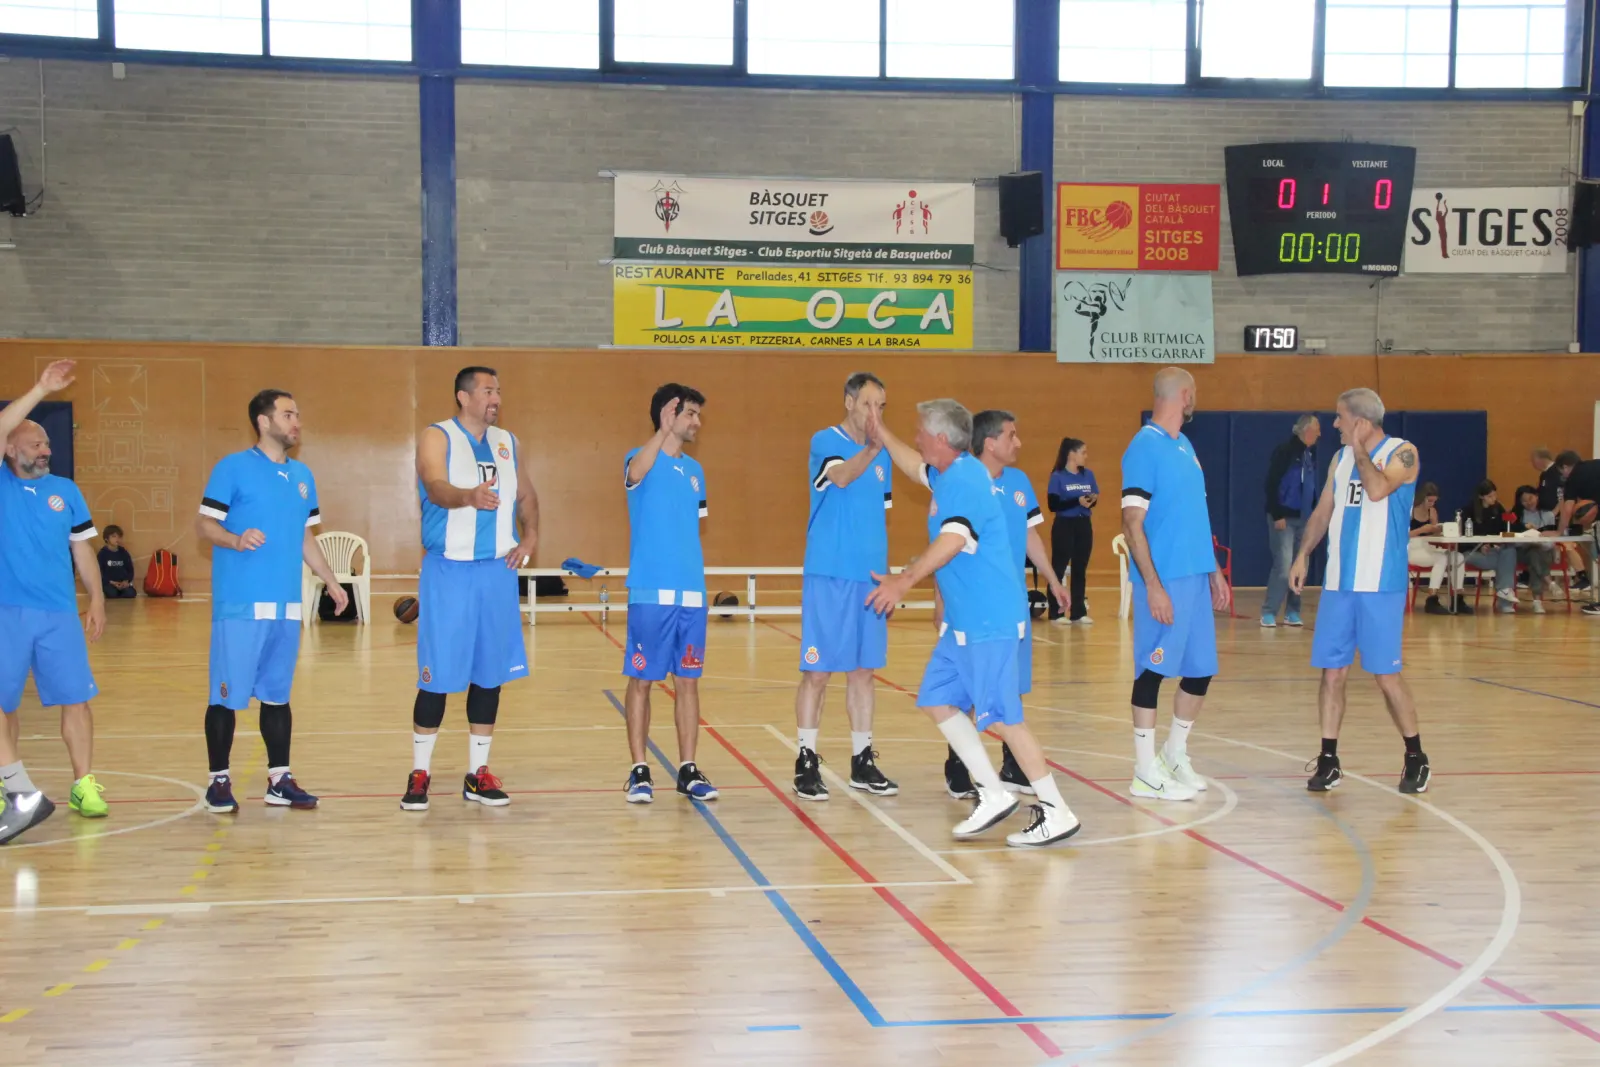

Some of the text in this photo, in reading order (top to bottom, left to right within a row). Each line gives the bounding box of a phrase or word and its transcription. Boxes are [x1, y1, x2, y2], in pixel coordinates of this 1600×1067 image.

[1352, 160, 1388, 168] VISITANTE
[749, 189, 829, 208] BÀSQUET
[1145, 193, 1180, 202] CIUTAT
[1278, 179, 1296, 209] 0
[1323, 183, 1330, 205] 1
[1374, 179, 1392, 209] 0
[1145, 203, 1215, 214] DEL BÀSQUET
[1306, 211, 1337, 219] PERIODO
[749, 210, 807, 226] SITGES
[1066, 208, 1102, 226] FBC
[1145, 213, 1184, 224] CATALÀ
[1554, 208, 1569, 246] 2008
[1144, 230, 1204, 244] SITGES
[638, 244, 664, 255] Club
[666, 244, 712, 257] Bàsquet
[713, 245, 747, 259] Sitges
[757, 247, 783, 257] Club
[785, 247, 832, 260] Esportiu
[833, 248, 873, 260] Sitgetà
[874, 248, 888, 259] de
[890, 249, 952, 262] Basquetbol
[1144, 247, 1189, 261] 2008
[1280, 232, 1360, 262] 00:00
[615, 266, 725, 281] RESTAURANTE
[817, 272, 862, 282] SITGES
[894, 273, 908, 283] 93
[912, 273, 933, 284] 894
[938, 274, 952, 284] 79
[958, 274, 971, 284] 36
[654, 286, 953, 330] LA OCA
[653, 334, 696, 344] POLLOS
[700, 335, 707, 344] A
[750, 336, 805, 347] PIZZERIA,
[810, 337, 853, 346] CARNES
[857, 337, 864, 346] A
[868, 337, 881, 346] LA
[886, 338, 920, 347] BRASA
[1100, 332, 1205, 345] CLUB RITMICA
[1101, 347, 1206, 359] SITGES GARRAF
